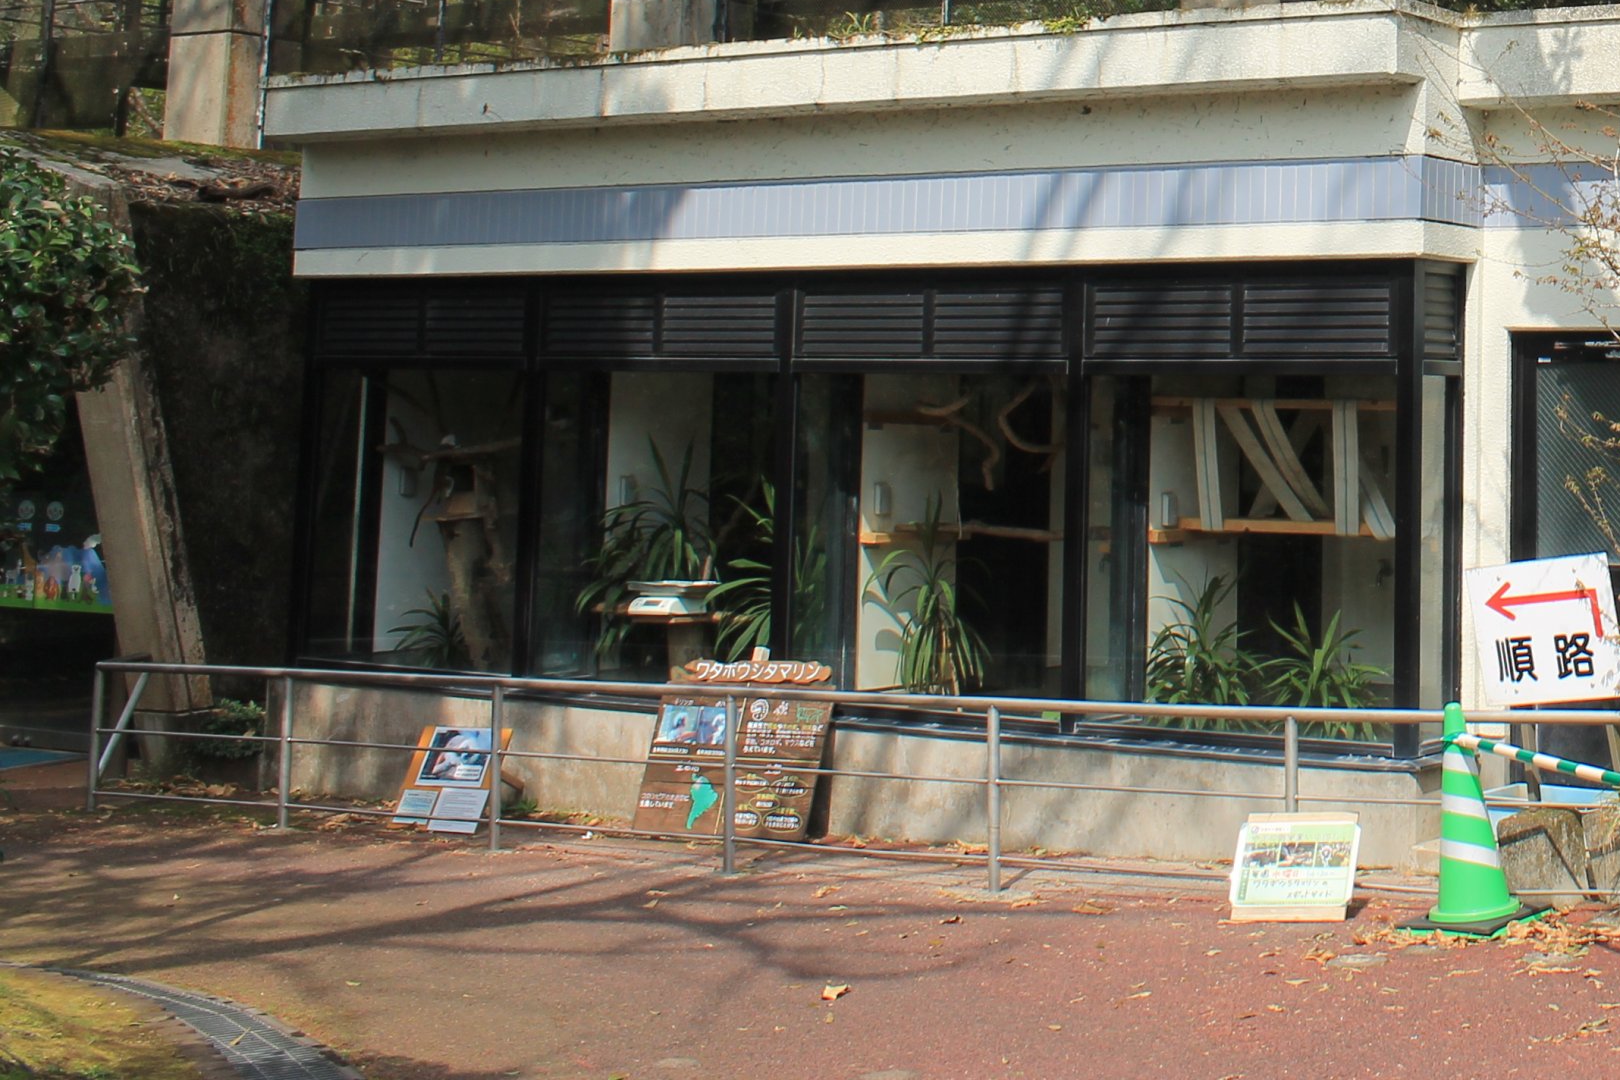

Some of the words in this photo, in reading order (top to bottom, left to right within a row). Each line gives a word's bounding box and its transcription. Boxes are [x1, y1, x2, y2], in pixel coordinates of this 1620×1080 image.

[696, 662, 821, 681] ワタボウシタマリン
[1495, 633, 1595, 683] 順路
